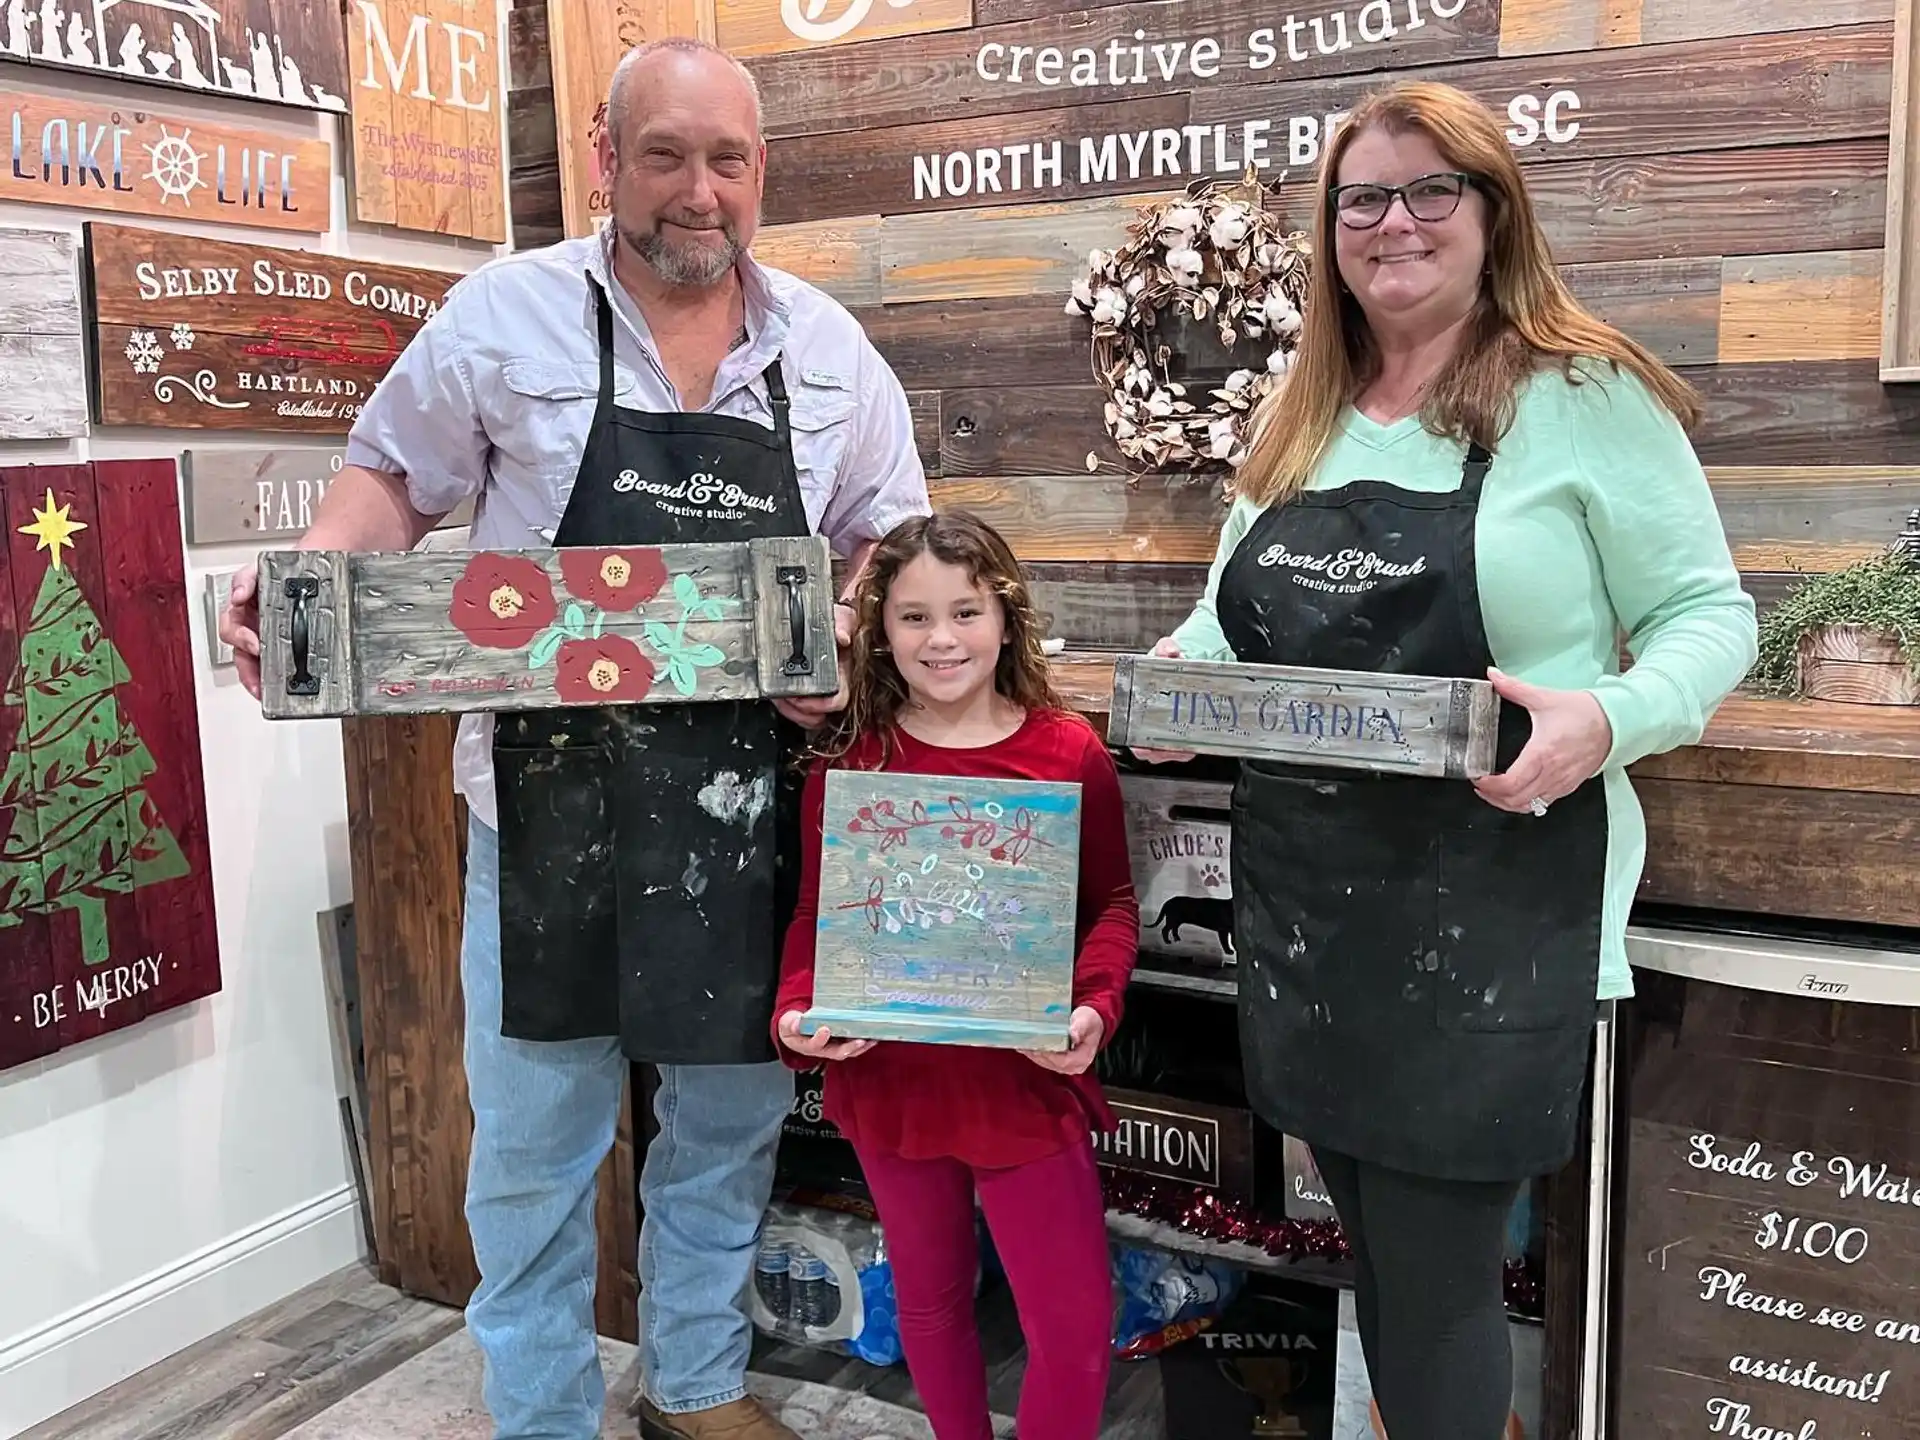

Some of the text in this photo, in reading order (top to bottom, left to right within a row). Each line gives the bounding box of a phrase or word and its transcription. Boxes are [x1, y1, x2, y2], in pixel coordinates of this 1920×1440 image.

[357, 1, 490, 112] ME
[975, 0, 1467, 87] creative studio
[360, 124, 398, 148] The
[913, 140, 1062, 200] NORTH
[1079, 118, 1271, 184] MYRTLE
[1505, 90, 1581, 147] SC
[12, 110, 299, 213] LAKE LIFE
[135, 261, 239, 300] SELBY
[253, 260, 331, 301] SLED
[237, 372, 366, 399] HARTLAND,
[613, 469, 777, 514] Board & Brush
[655, 499, 743, 520] creative studio
[1257, 543, 1427, 580] Board & Brush
[1292, 573, 1373, 594] creative studio
[1168, 689, 1406, 744] TINY GARDEN
[1150, 834, 1224, 861] CHLOE'S
[33, 952, 163, 1028] BE MERRY
[1688, 1133, 1777, 1181] Soda
[1785, 1151, 1818, 1187] &
[1754, 1210, 1869, 1264] $1.00
[1698, 1266, 1920, 1344] Please see an
[1199, 1332, 1318, 1350] TRIVIA
[1729, 1353, 1891, 1403] assistant!
